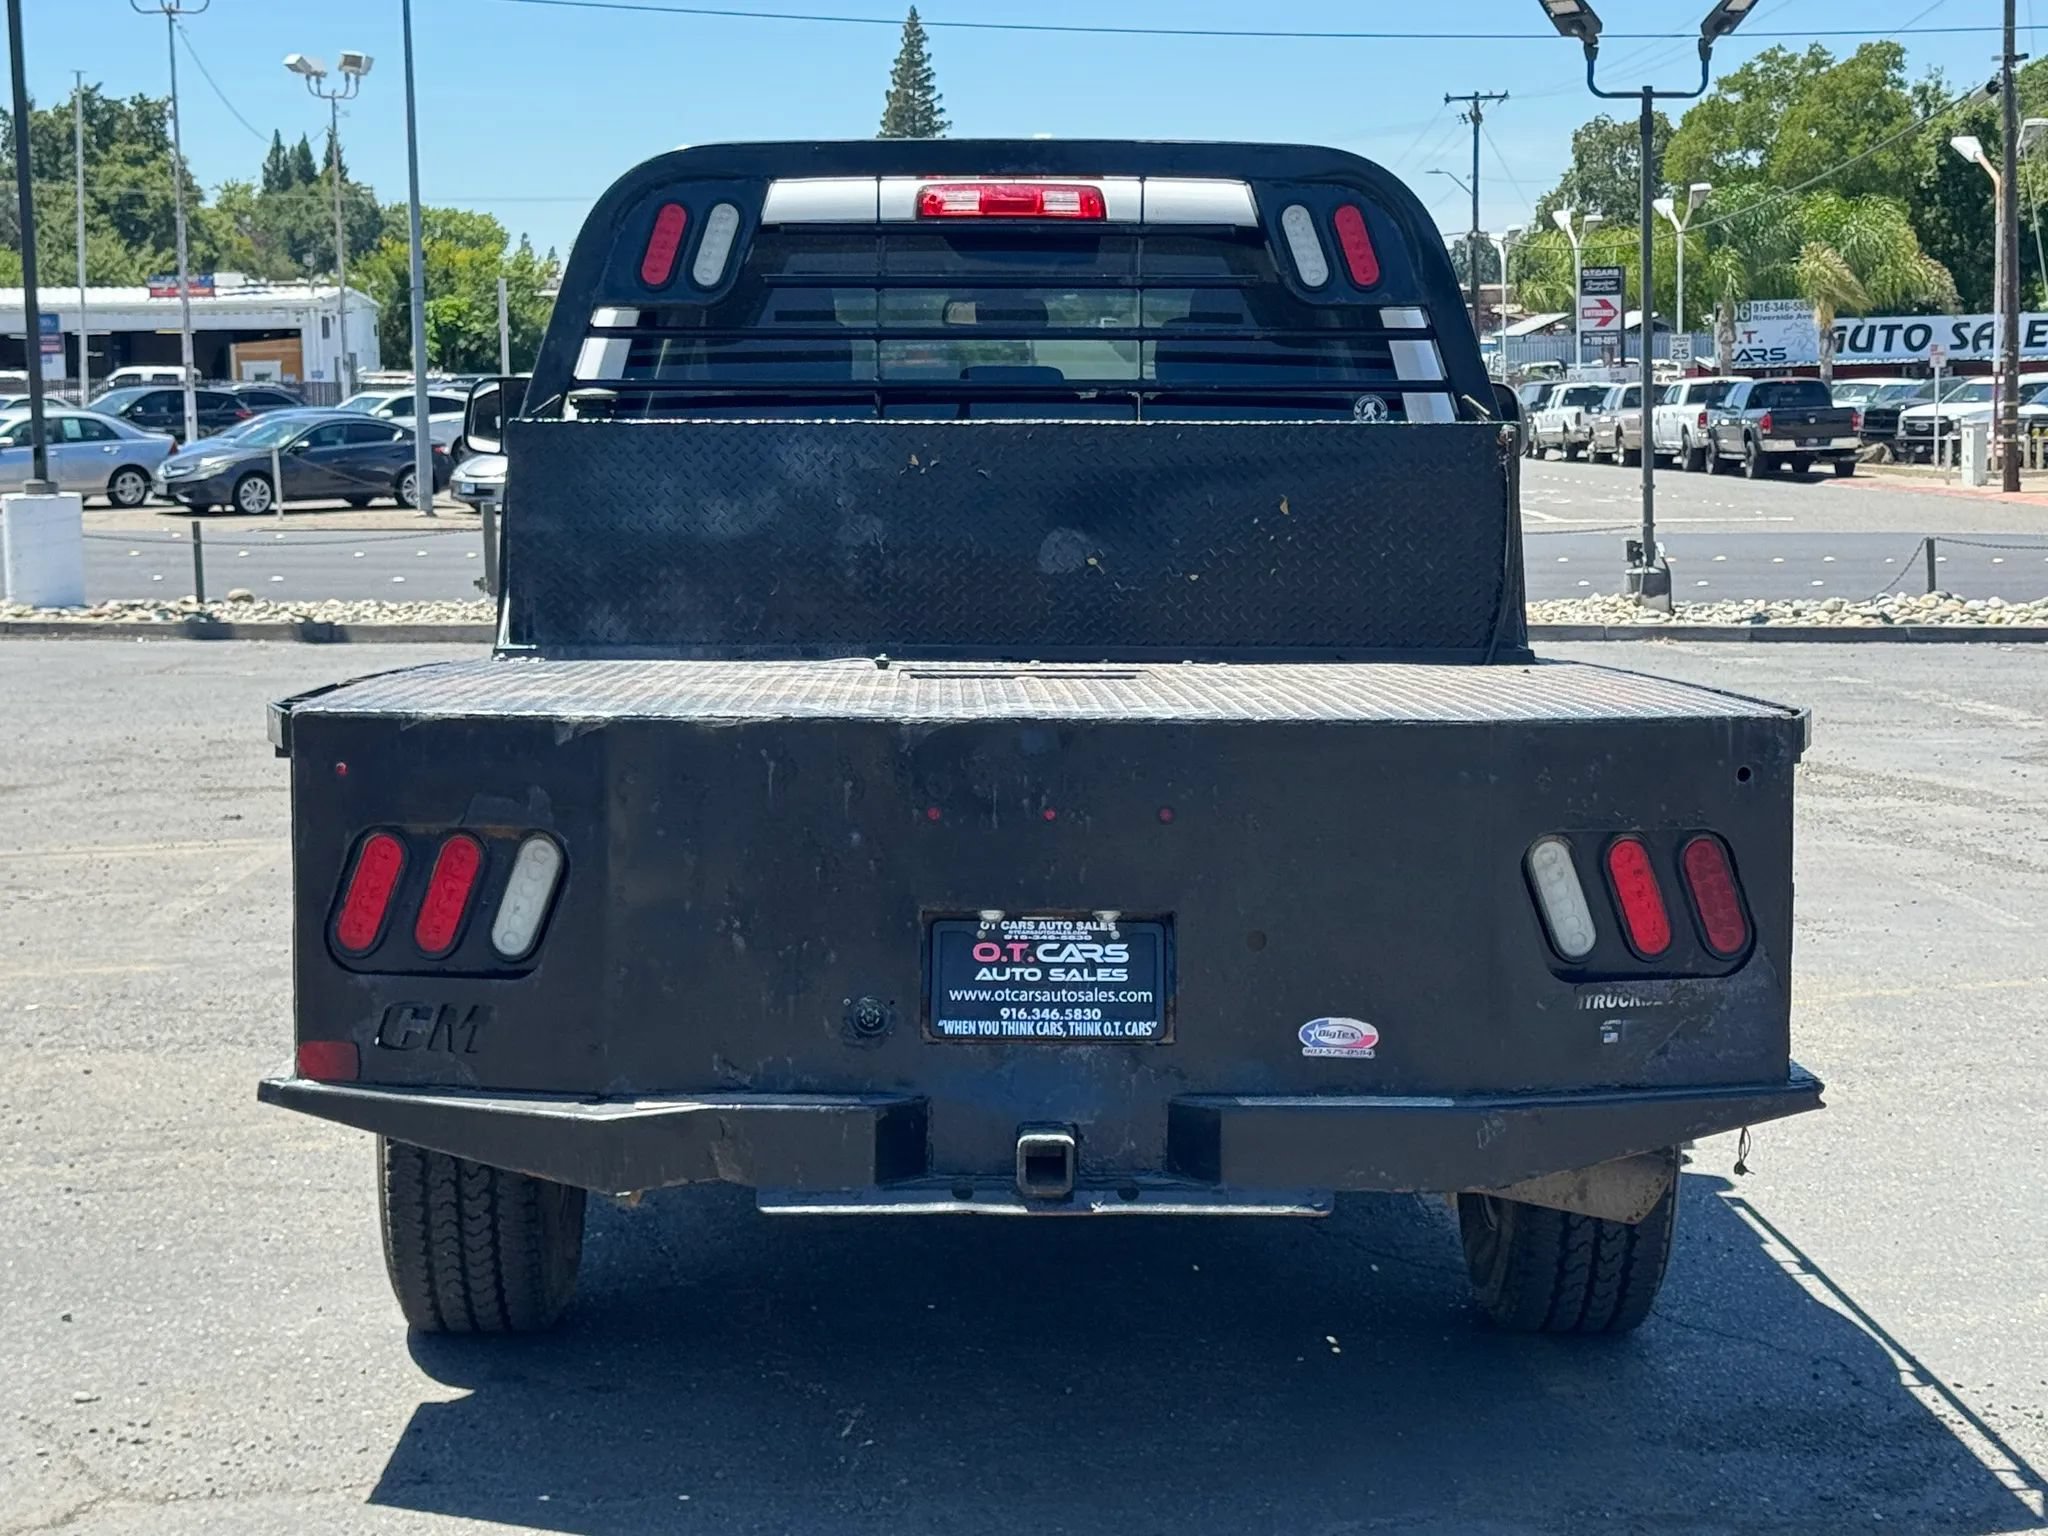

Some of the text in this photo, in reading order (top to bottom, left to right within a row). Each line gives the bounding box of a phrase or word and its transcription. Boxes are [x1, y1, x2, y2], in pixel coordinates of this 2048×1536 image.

[1672, 348, 1689, 360] 25
[1719, 347, 1787, 362] ARS
[1000, 920, 1035, 930] CARS
[1040, 920, 1073, 931] AUTO
[1076, 920, 1116, 932] SALES
[975, 968, 1129, 982] AUTO SALES
[949, 987, 1153, 1003] www.otcarsautosales.com
[1000, 1007, 1101, 1020] 916.346.5830
[978, 1021, 1000, 1036] YOU
[1001, 1021, 1035, 1036] THINK
[1036, 1021, 1067, 1038] CARS,
[1068, 1021, 1102, 1036] THINK
[1103, 1021, 1123, 1036] O.T.
